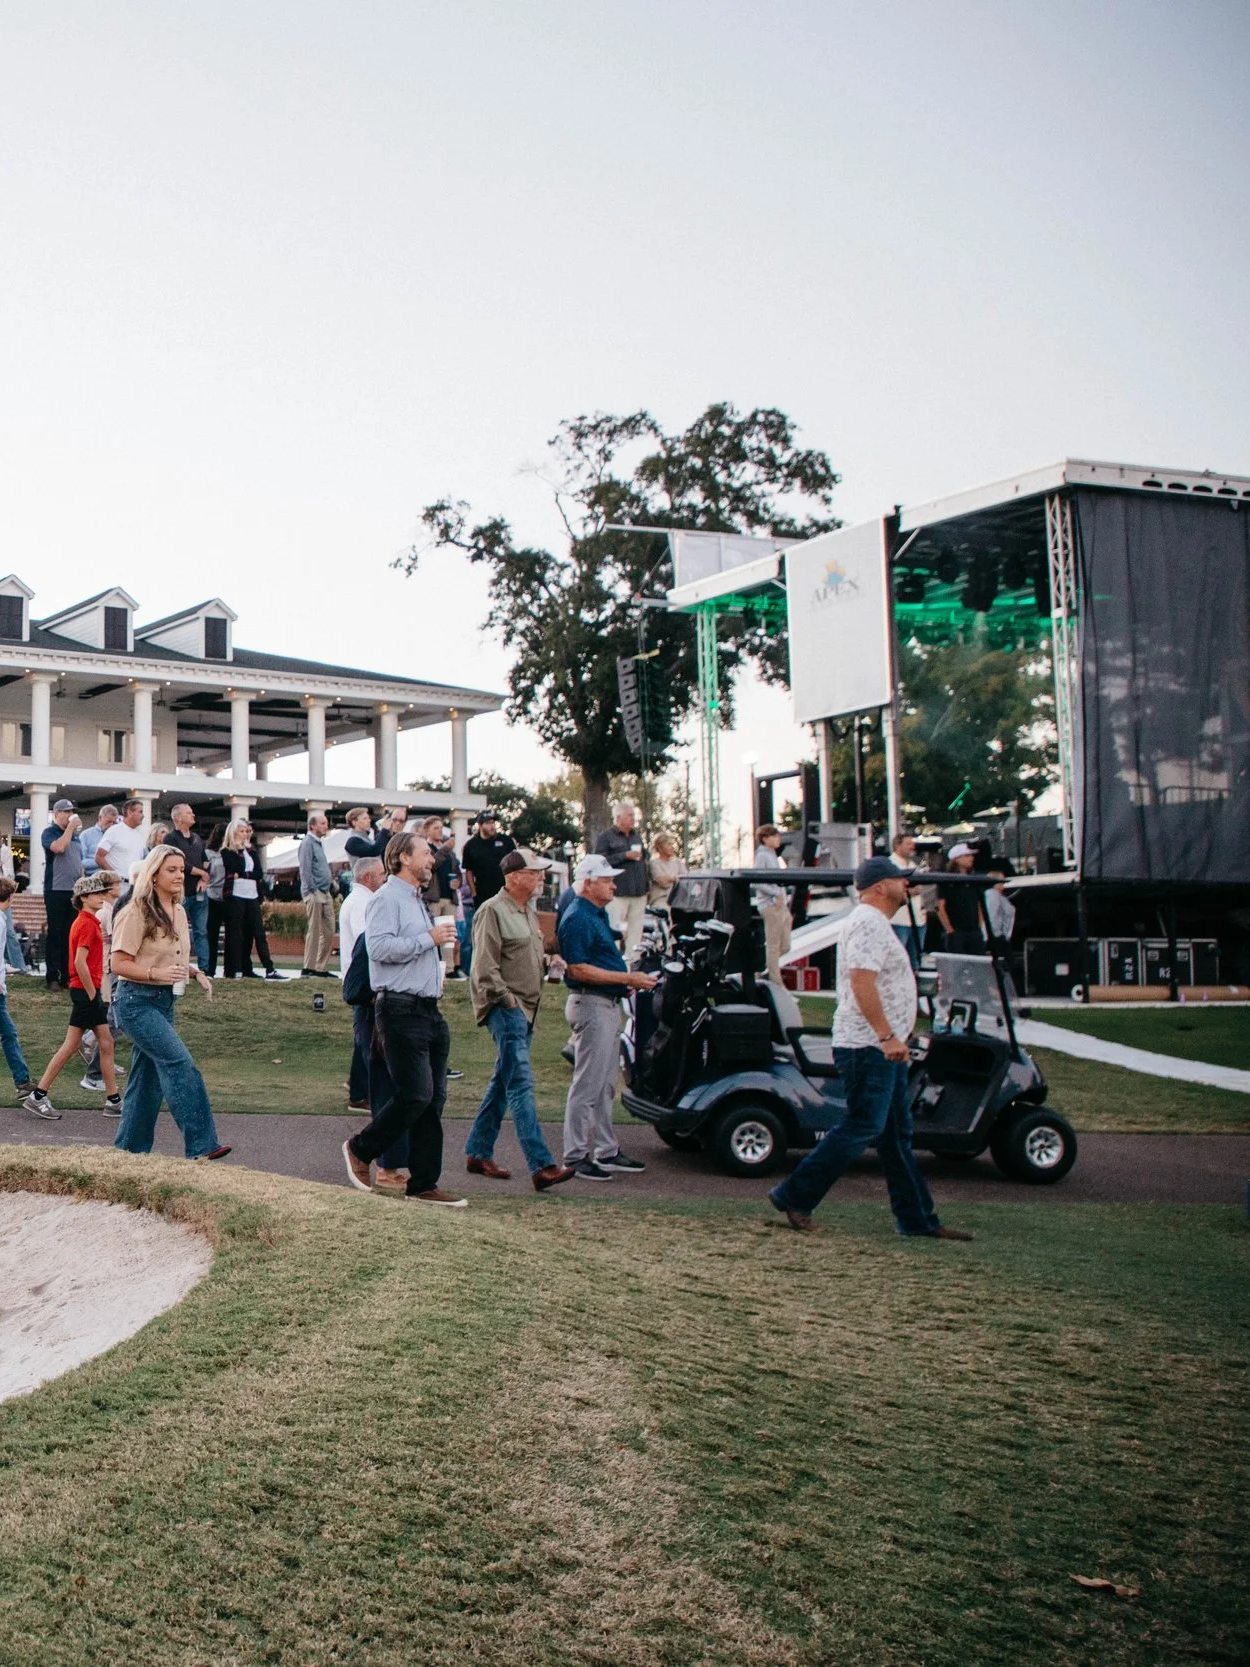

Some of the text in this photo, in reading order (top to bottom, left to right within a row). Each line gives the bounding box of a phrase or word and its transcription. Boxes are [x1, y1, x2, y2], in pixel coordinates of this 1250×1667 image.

[810, 577, 859, 605] APEX
[1159, 967, 1170, 978] R2
[815, 1131, 829, 1140] YA
